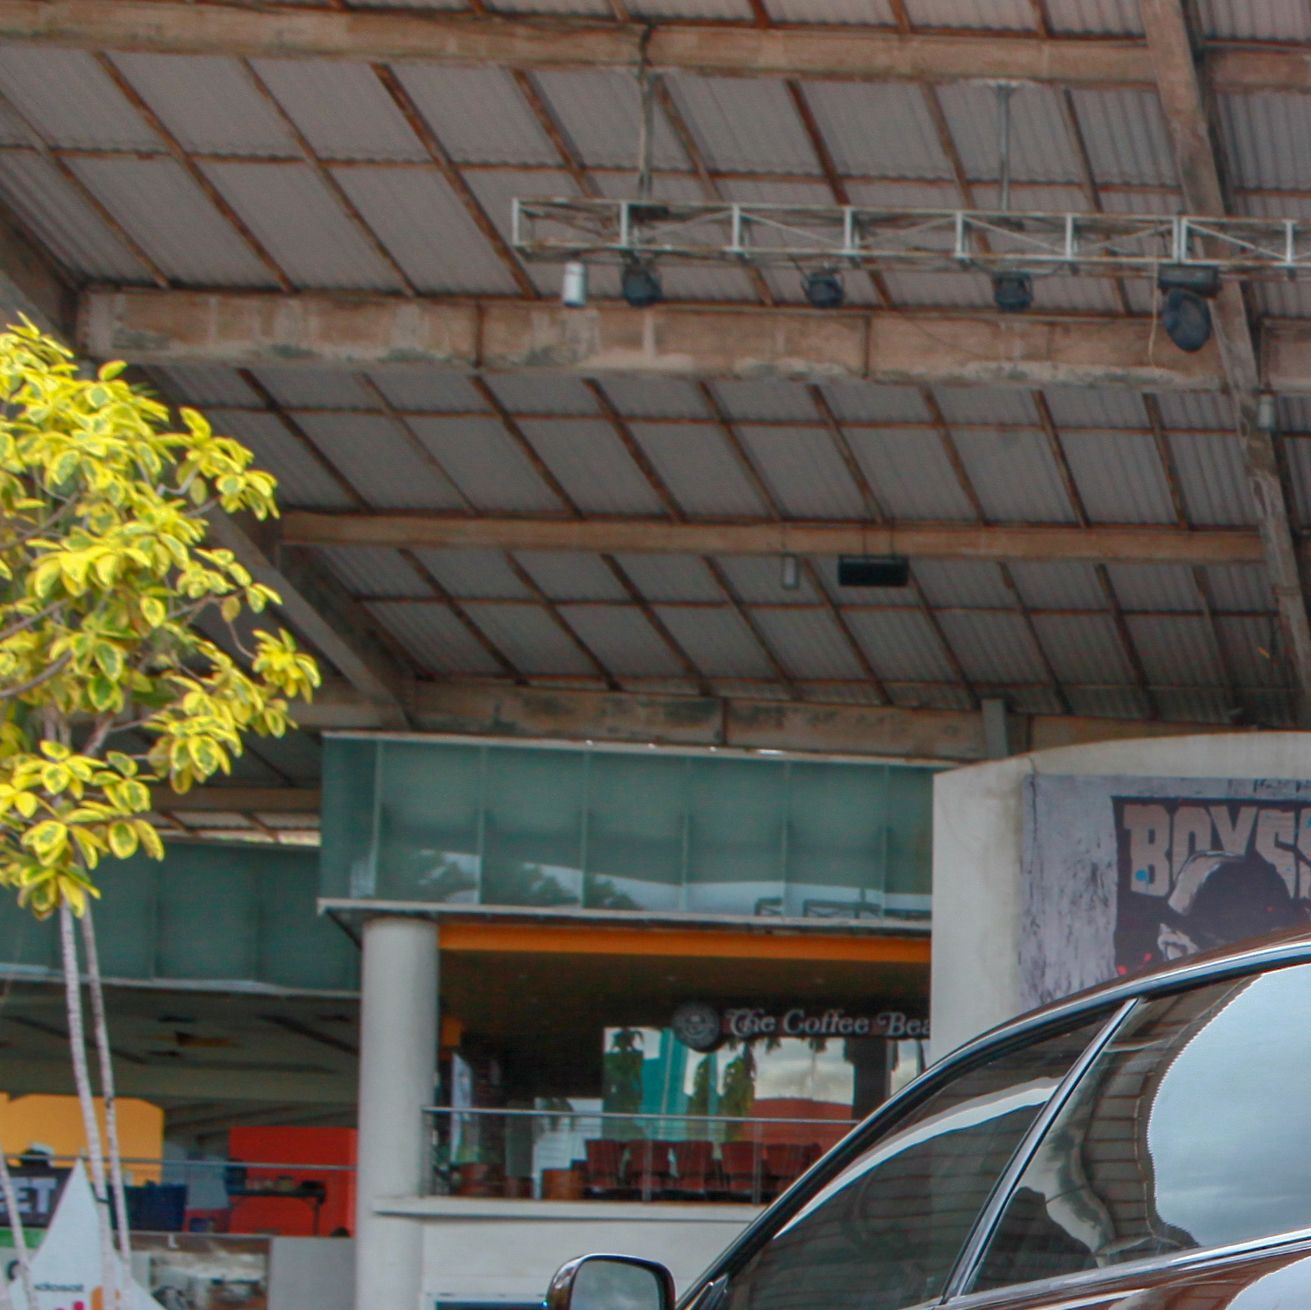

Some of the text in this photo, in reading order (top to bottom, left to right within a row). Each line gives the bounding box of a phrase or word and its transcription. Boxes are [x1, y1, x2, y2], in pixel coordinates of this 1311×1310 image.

[726, 1008, 930, 1038] The Coffee Bea
